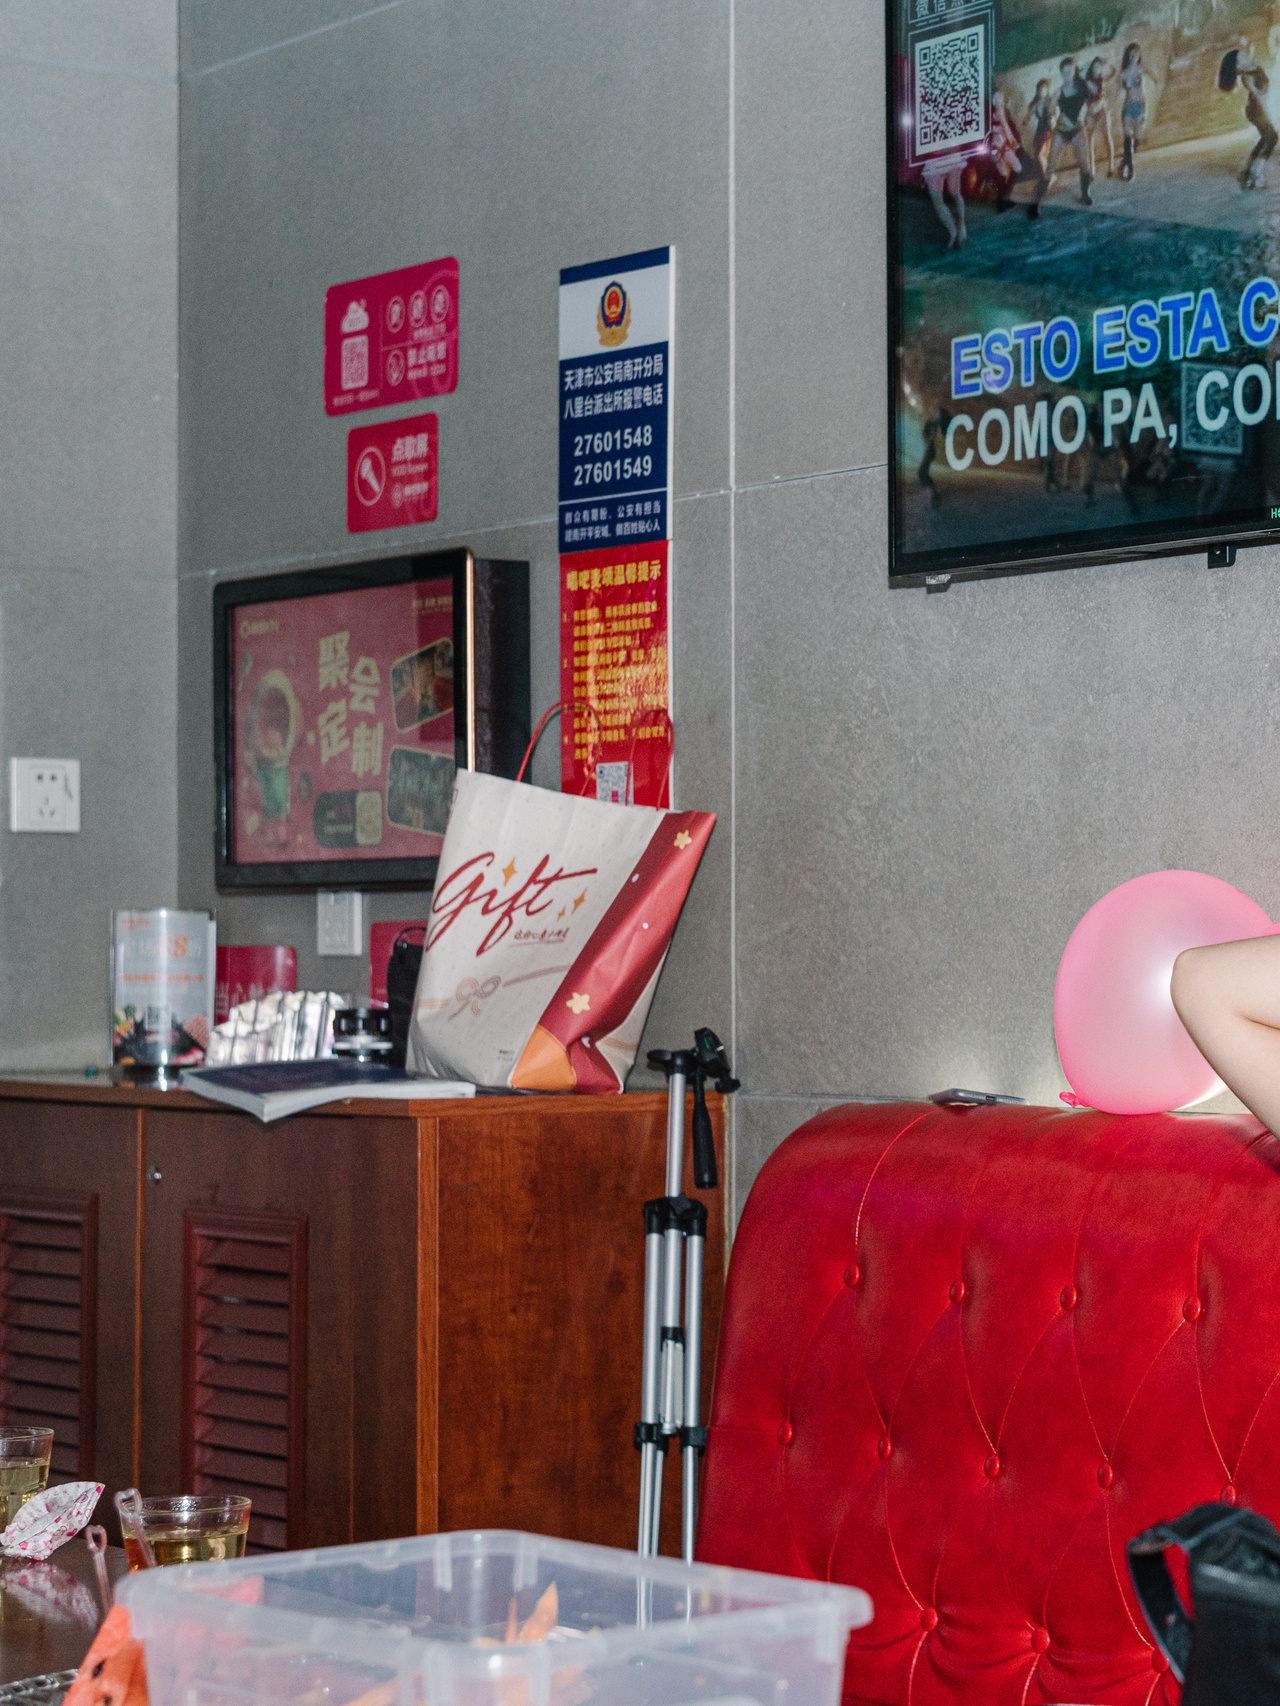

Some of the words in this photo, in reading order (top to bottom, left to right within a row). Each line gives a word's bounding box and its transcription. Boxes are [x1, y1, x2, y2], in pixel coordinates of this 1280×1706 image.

[951, 315, 1081, 400] ESTO
[1093, 287, 1230, 375] ESTA
[564, 353, 663, 391] 天津市公安局南开分局
[564, 383, 663, 419] 八里台派出所报警电话
[574, 425, 652, 457] 27601548
[945, 395, 1087, 471] COMO
[1103, 382, 1178, 450] PA,
[574, 455, 652, 486] 27601549
